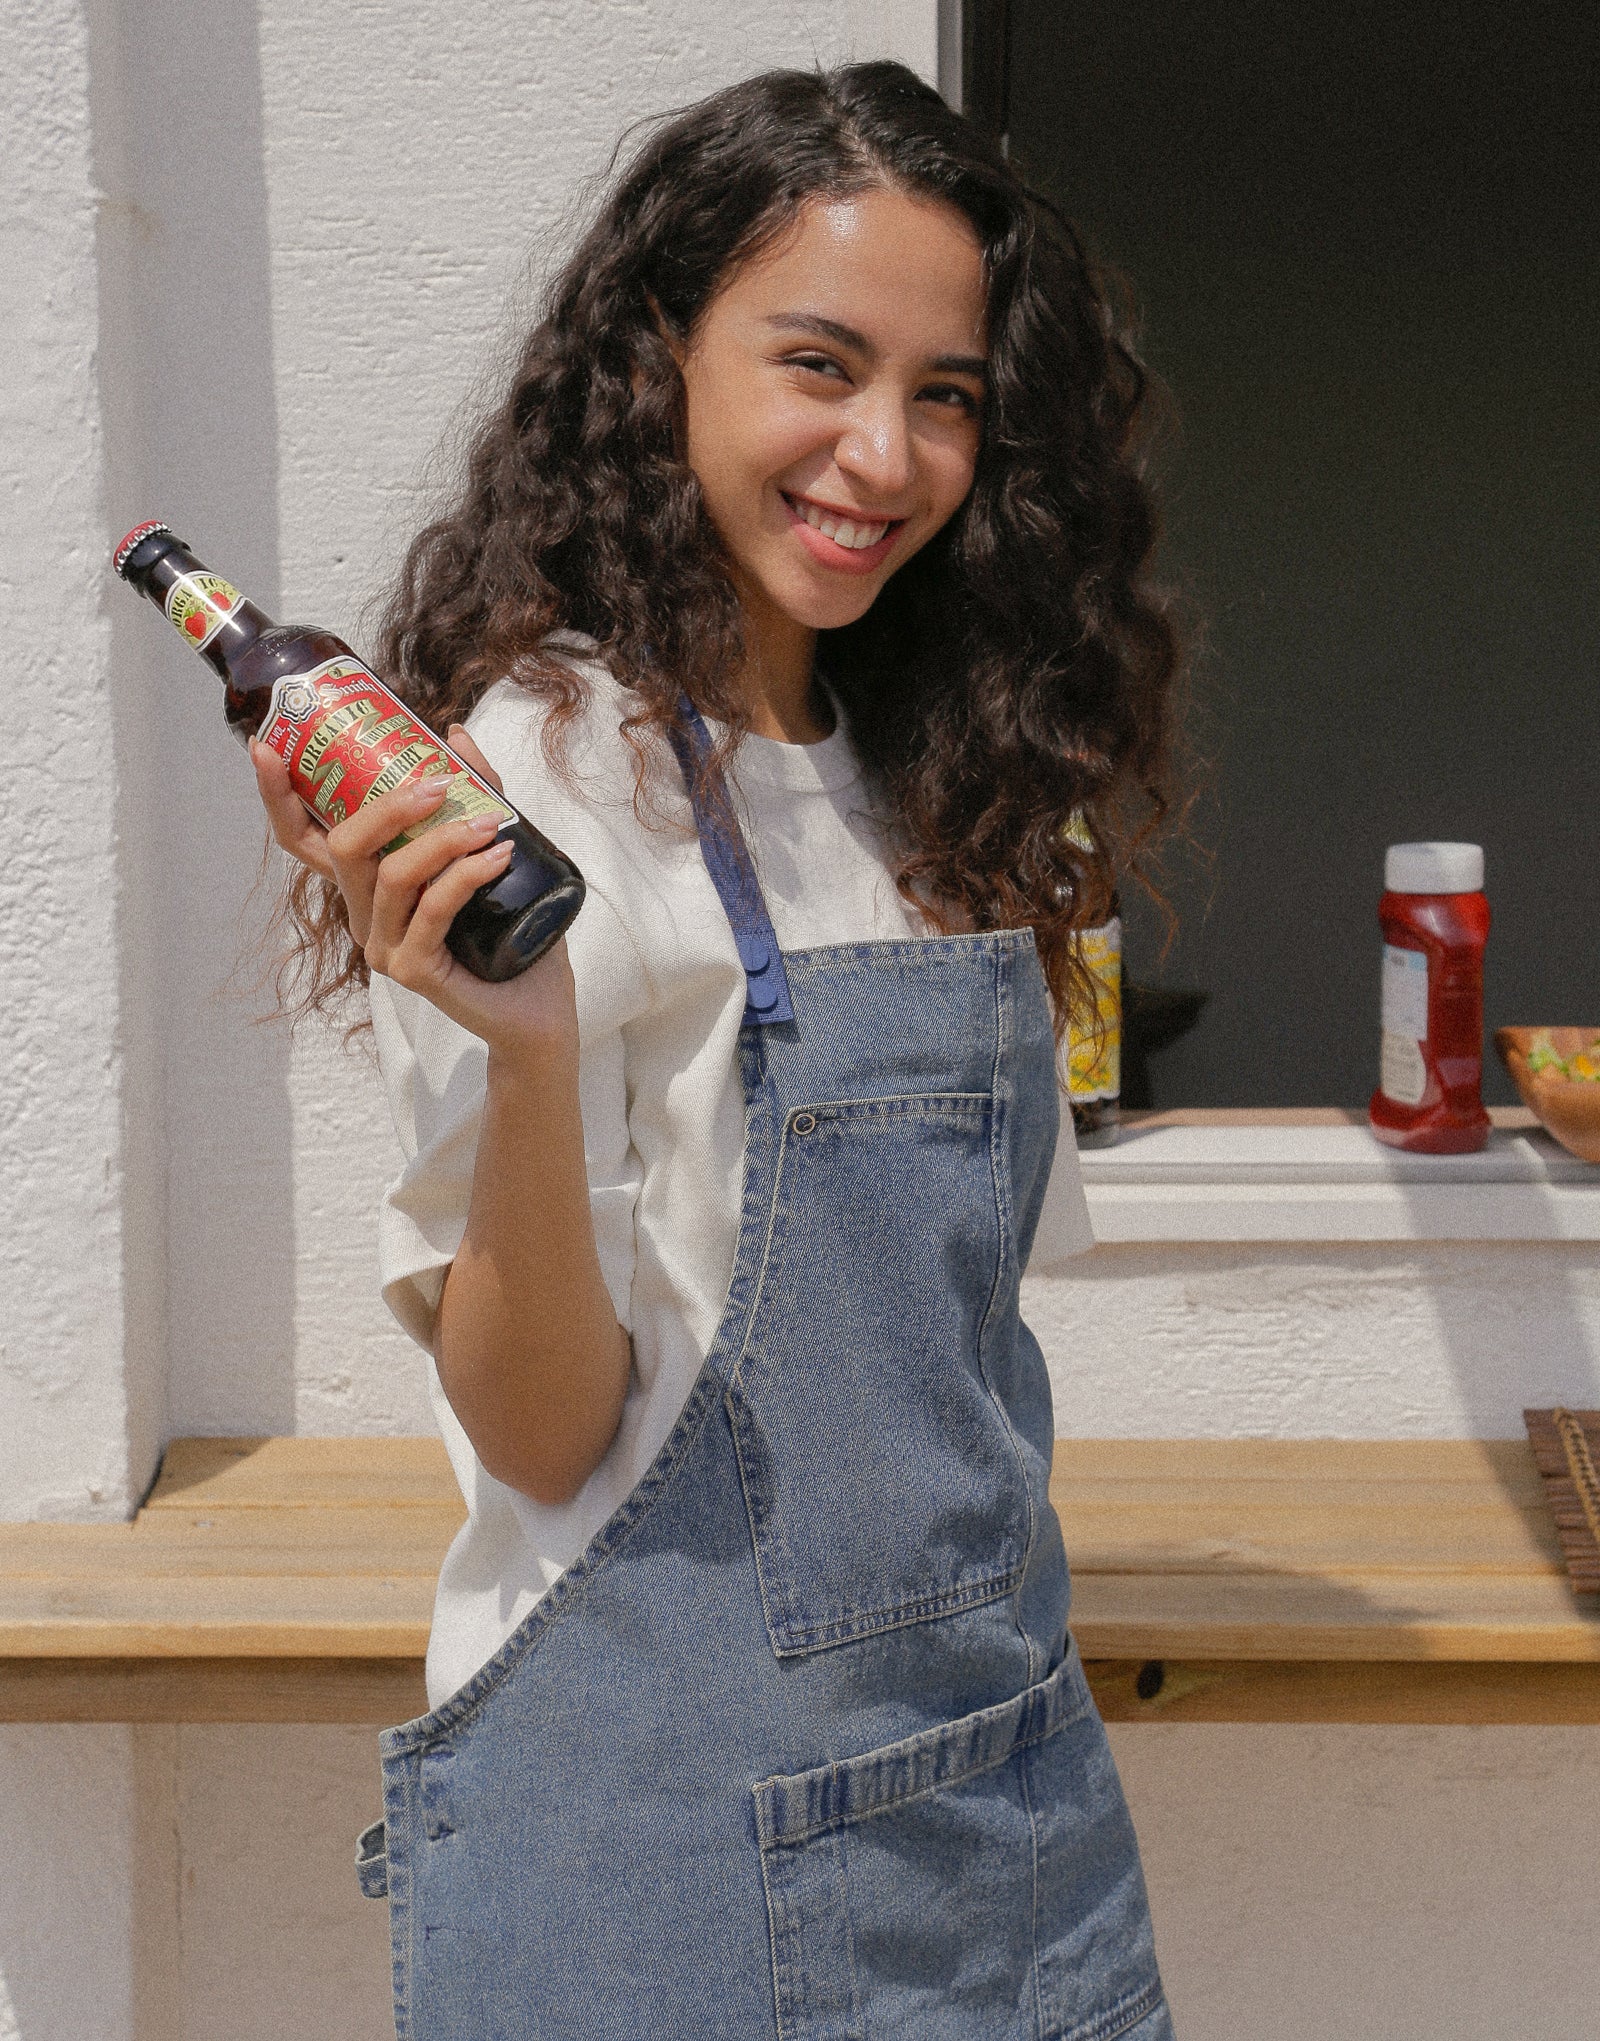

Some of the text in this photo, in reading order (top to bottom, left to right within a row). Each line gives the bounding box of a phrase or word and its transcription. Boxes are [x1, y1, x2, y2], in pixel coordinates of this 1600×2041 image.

[171, 577, 218, 628] ORGAIC
[319, 679, 382, 708] Smith
[300, 700, 370, 773] ORGANIC
[361, 724, 390, 746] FRUIT
